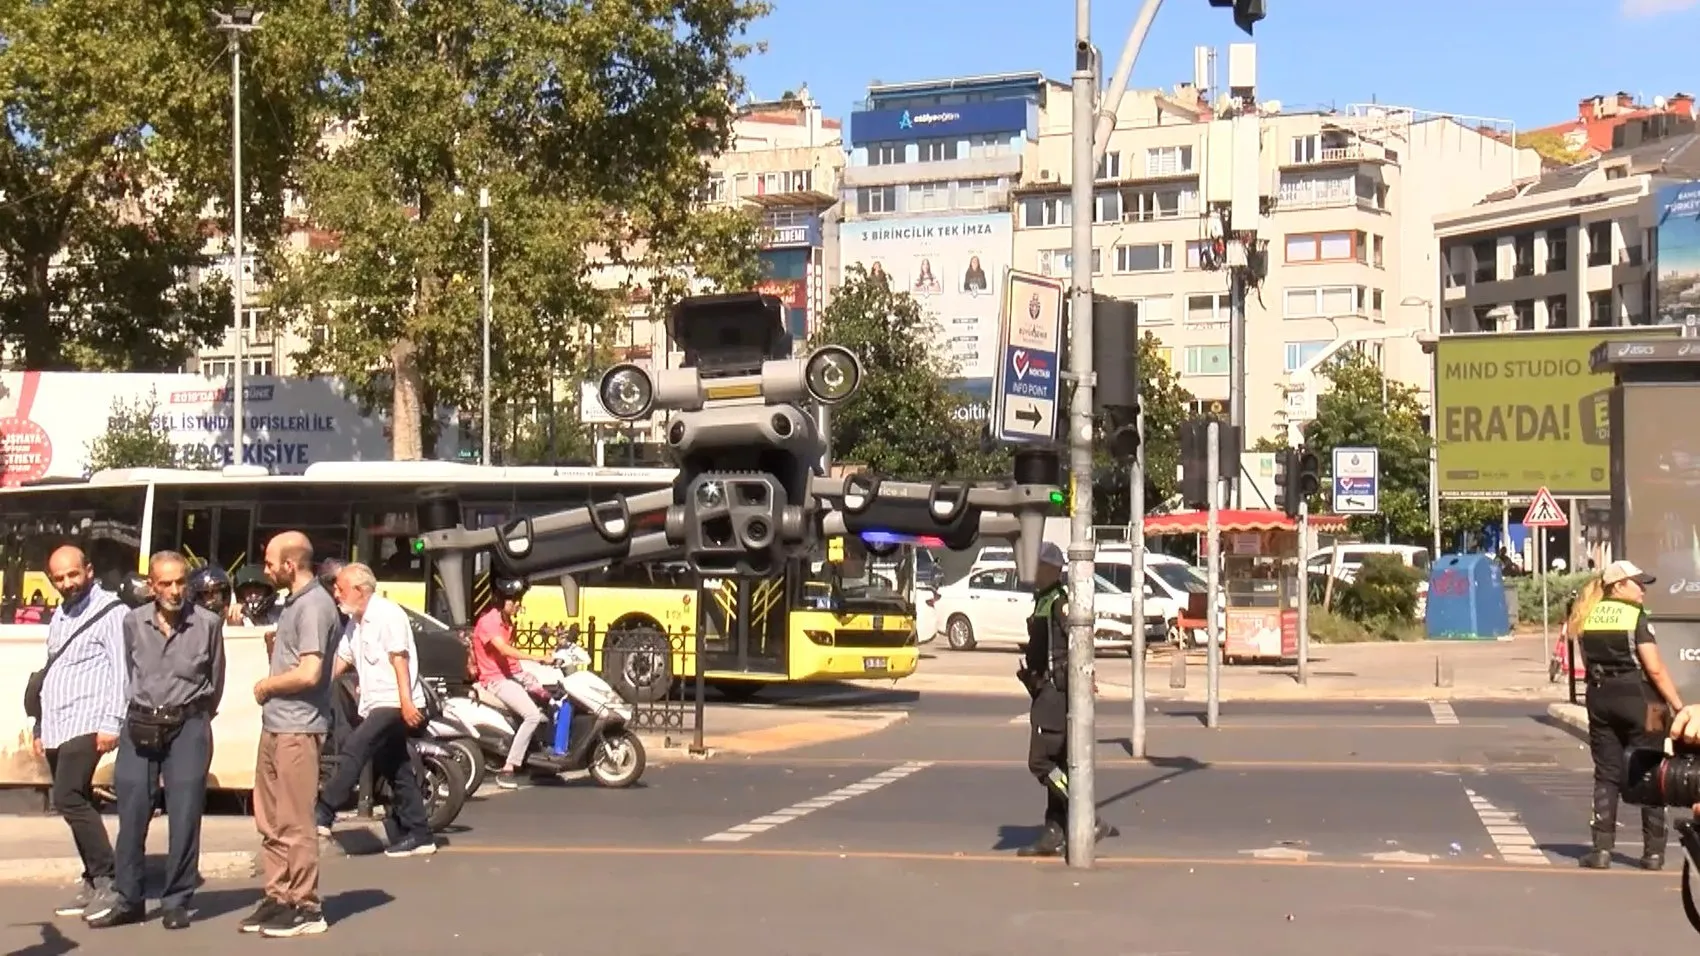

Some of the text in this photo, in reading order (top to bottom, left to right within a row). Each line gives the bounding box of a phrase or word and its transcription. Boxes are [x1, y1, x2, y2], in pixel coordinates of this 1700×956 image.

[862, 222, 992, 241] 3 BİRİNCİLİK TEK İMZA
[1445, 358, 1581, 379] MIND STUDIO
[1446, 404, 1570, 442] ERA'DA!
